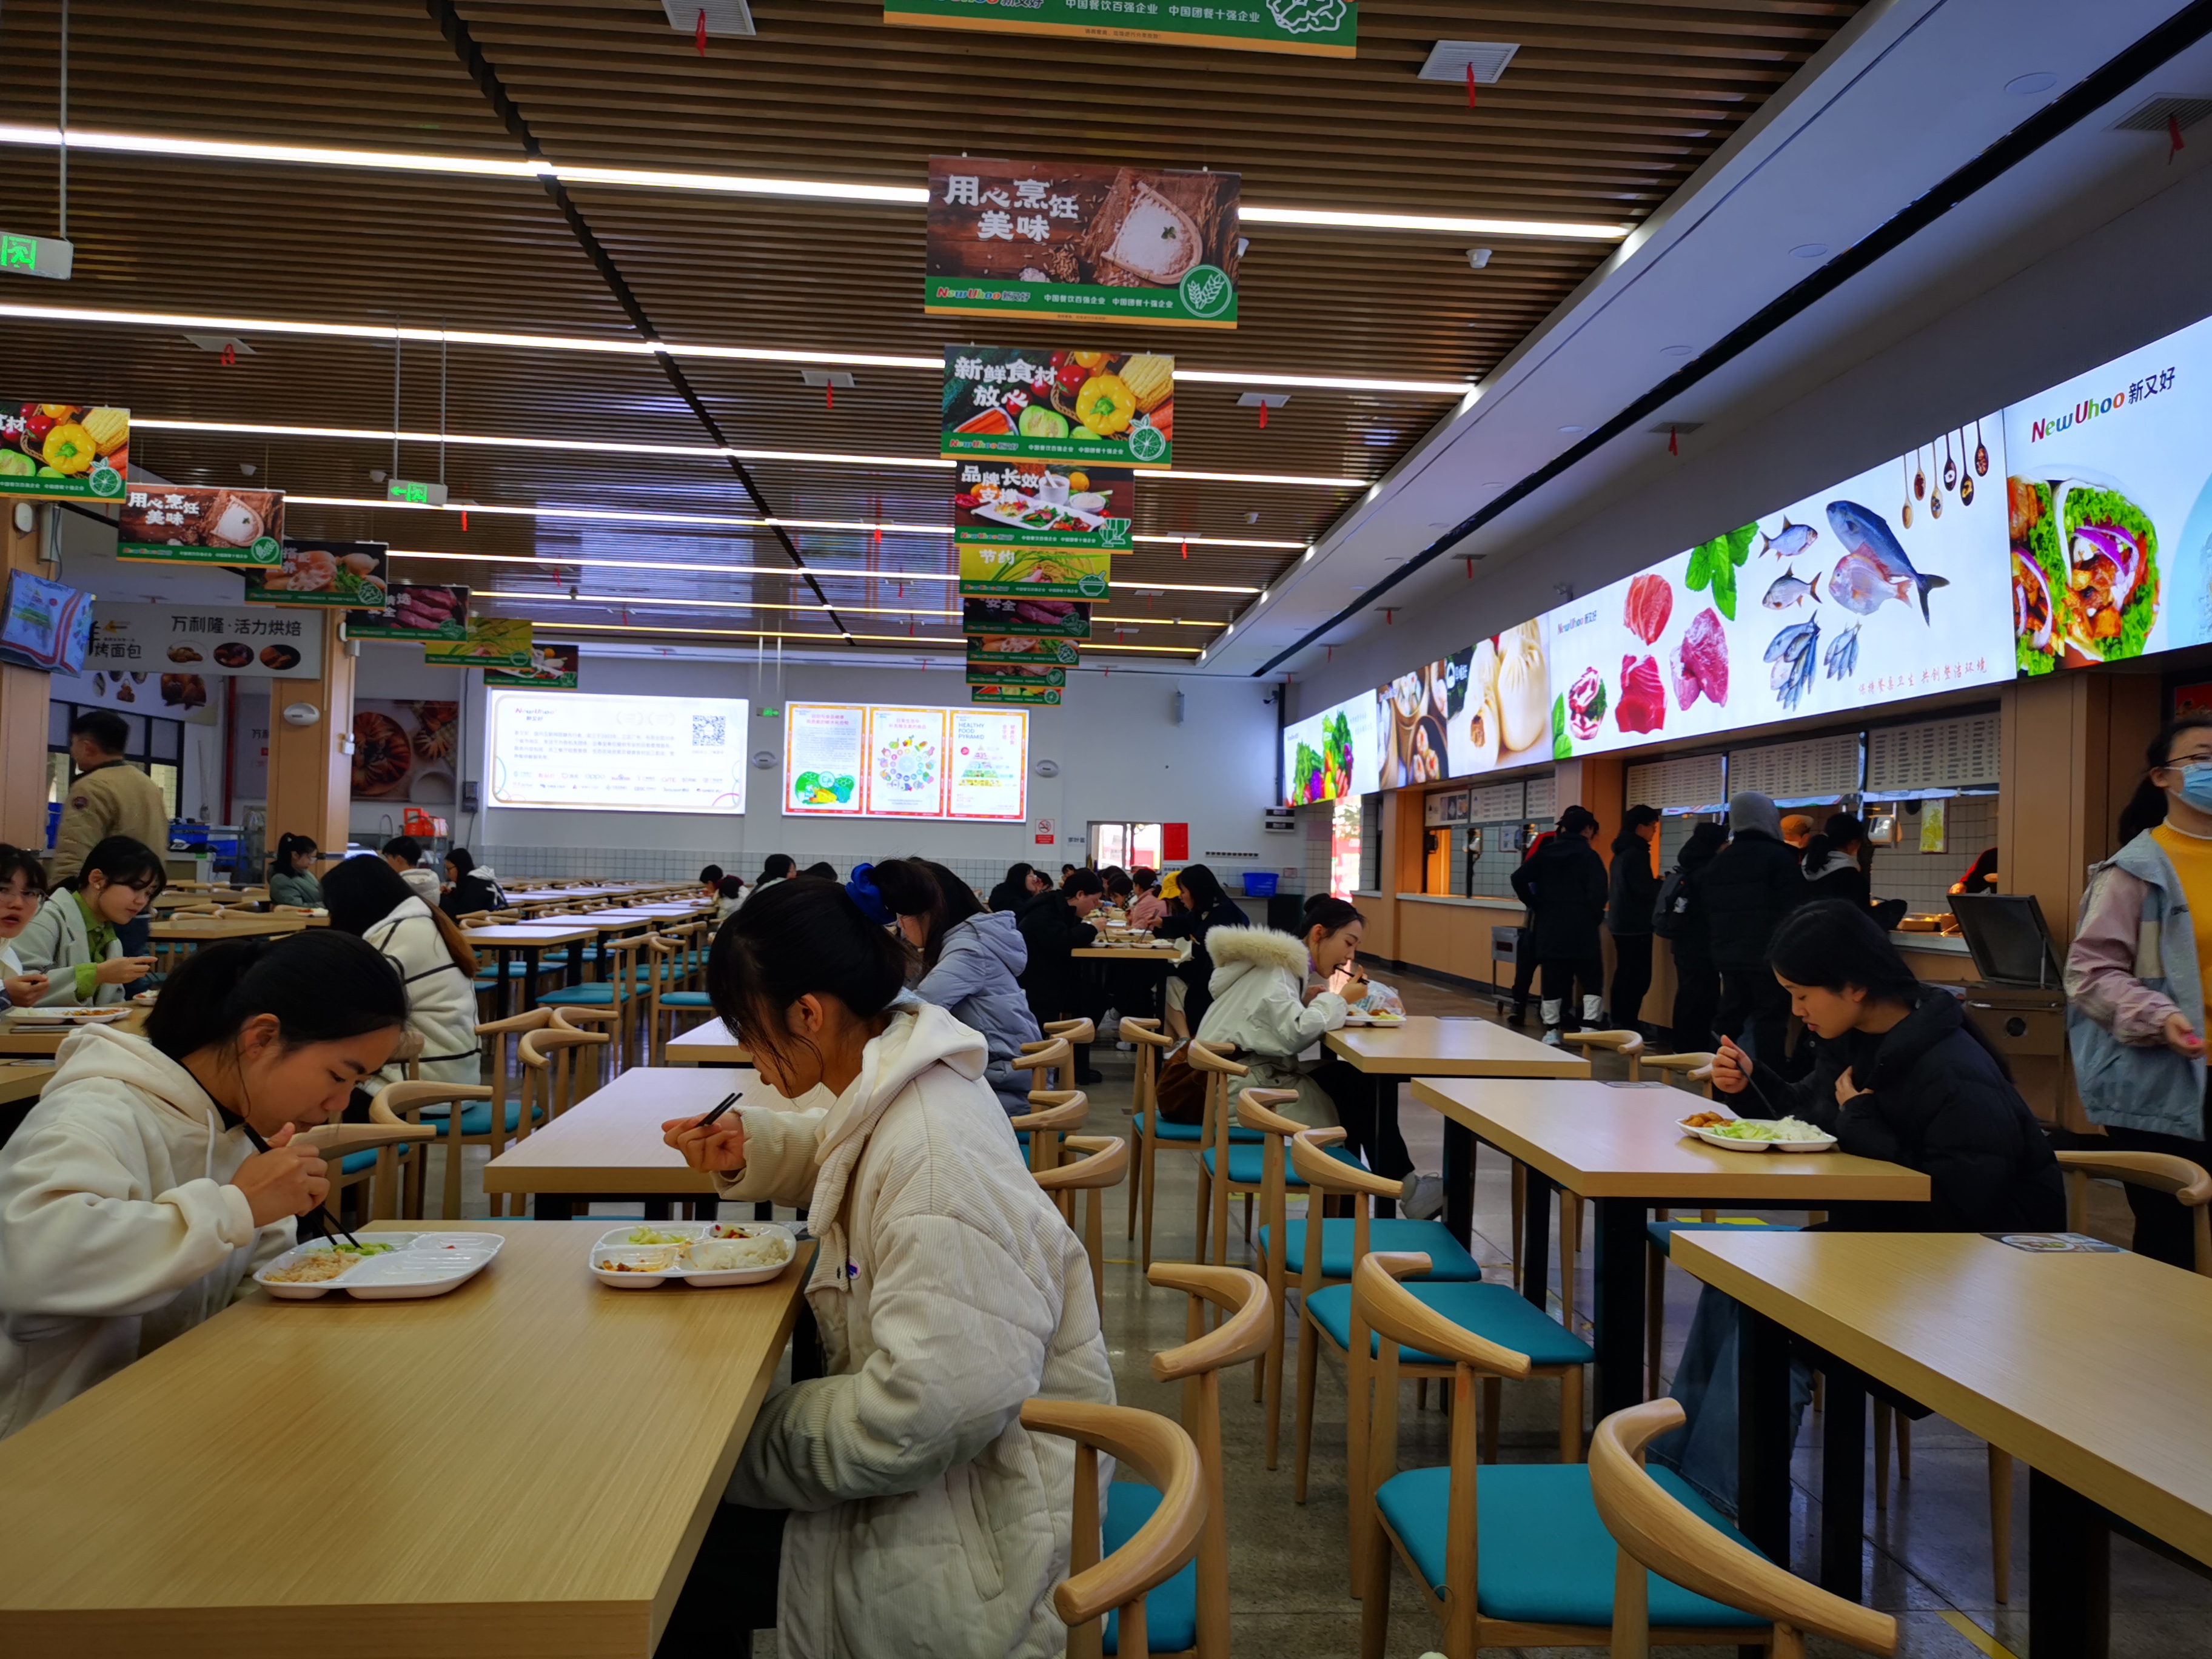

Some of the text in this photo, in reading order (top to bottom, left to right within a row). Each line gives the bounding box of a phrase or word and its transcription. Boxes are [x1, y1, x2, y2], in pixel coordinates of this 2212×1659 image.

[1065, 0, 1260, 22] 中国餐饮百强企业 中国团餐十强企业
[943, 174, 1079, 220] 用心烹饪
[977, 210, 1050, 241] 美味
[937, 287, 1001, 301] NewUhoo
[954, 356, 1057, 386] 新鲜食材
[973, 384, 1029, 407] 放心
[2031, 367, 2176, 443] NewUhoo 新又好
[961, 465, 1039, 488] 品牌长效
[128, 492, 199, 515] 用心烹饪
[146, 509, 185, 526] 美味
[979, 549, 1015, 565] 节约
